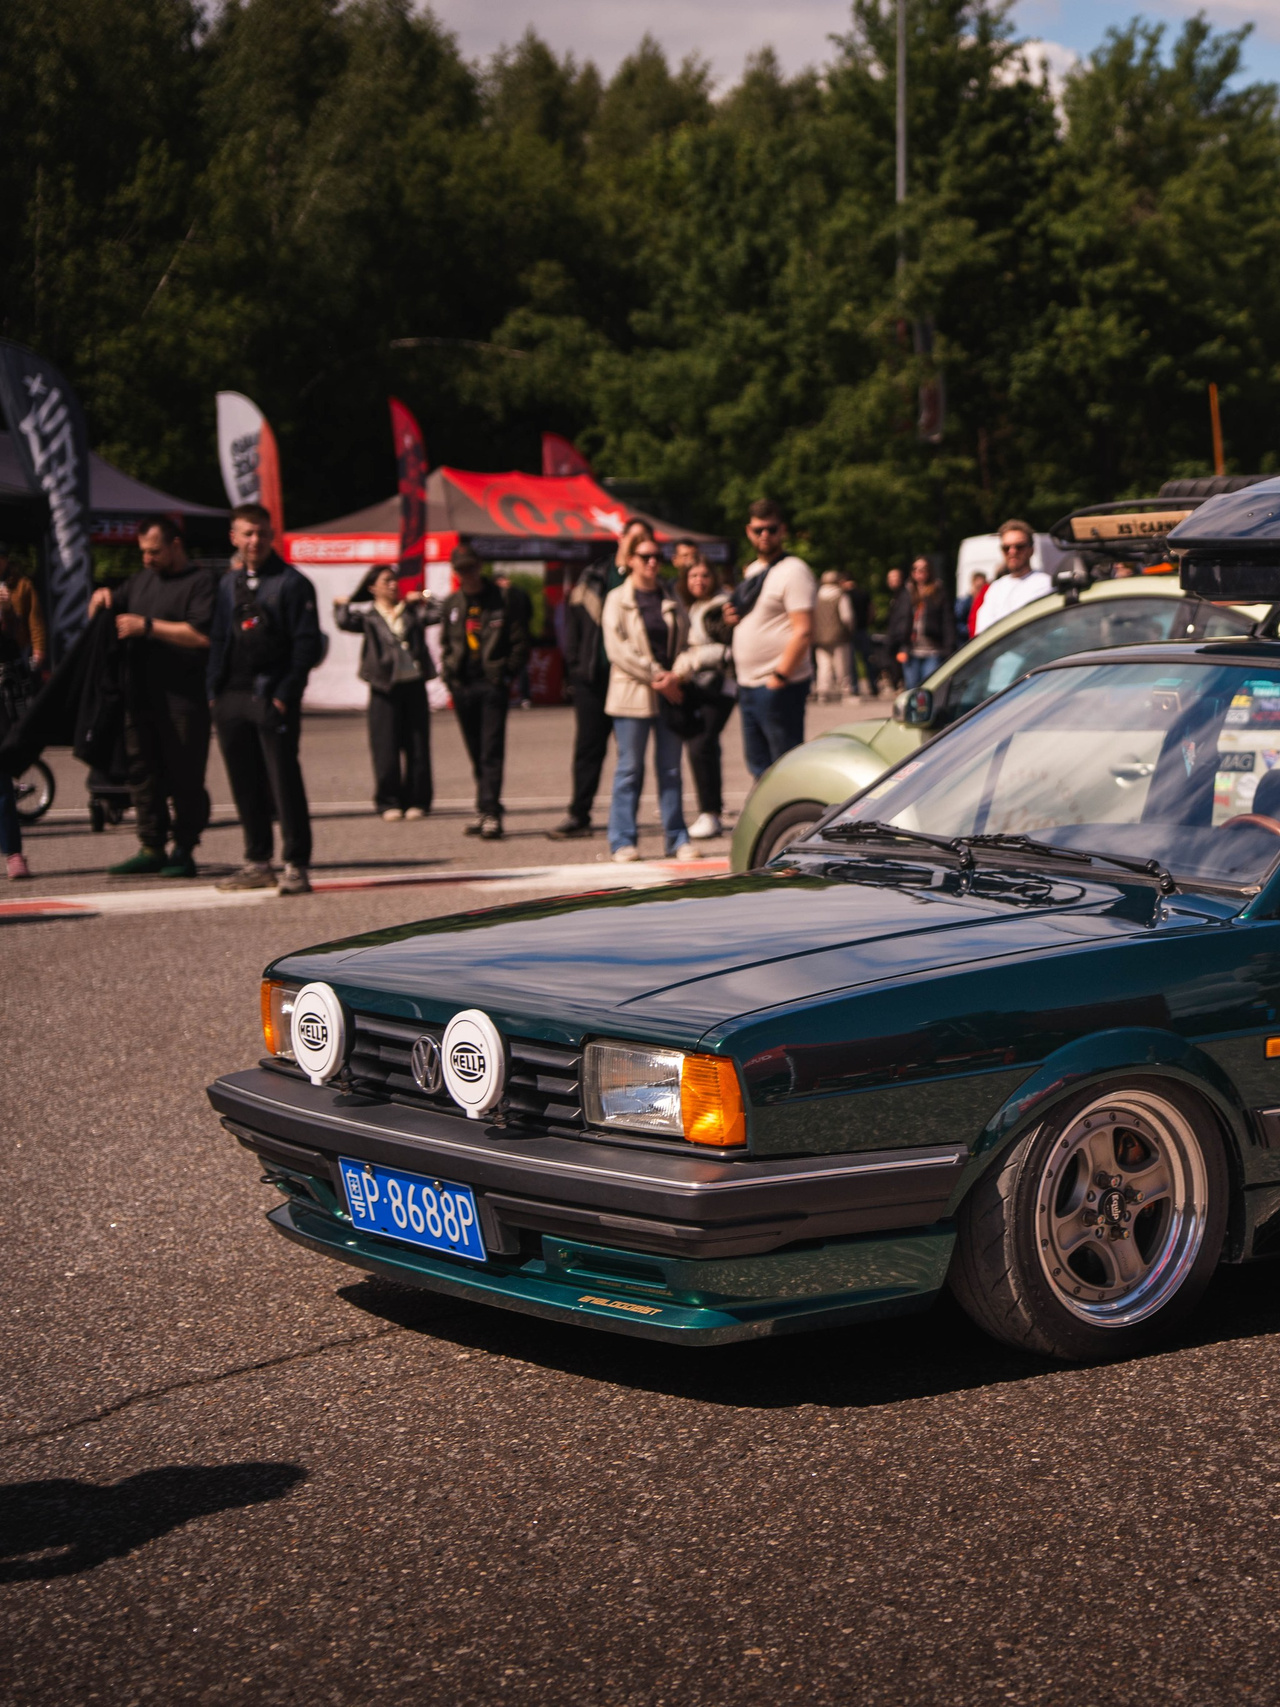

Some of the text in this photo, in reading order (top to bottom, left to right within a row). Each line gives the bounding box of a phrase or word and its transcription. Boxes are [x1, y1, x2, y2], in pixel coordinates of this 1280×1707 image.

[300, 1022, 328, 1042] HELLA
[452, 1052, 486, 1074] HELLA
[1111, 1195, 1121, 1220] Equip
